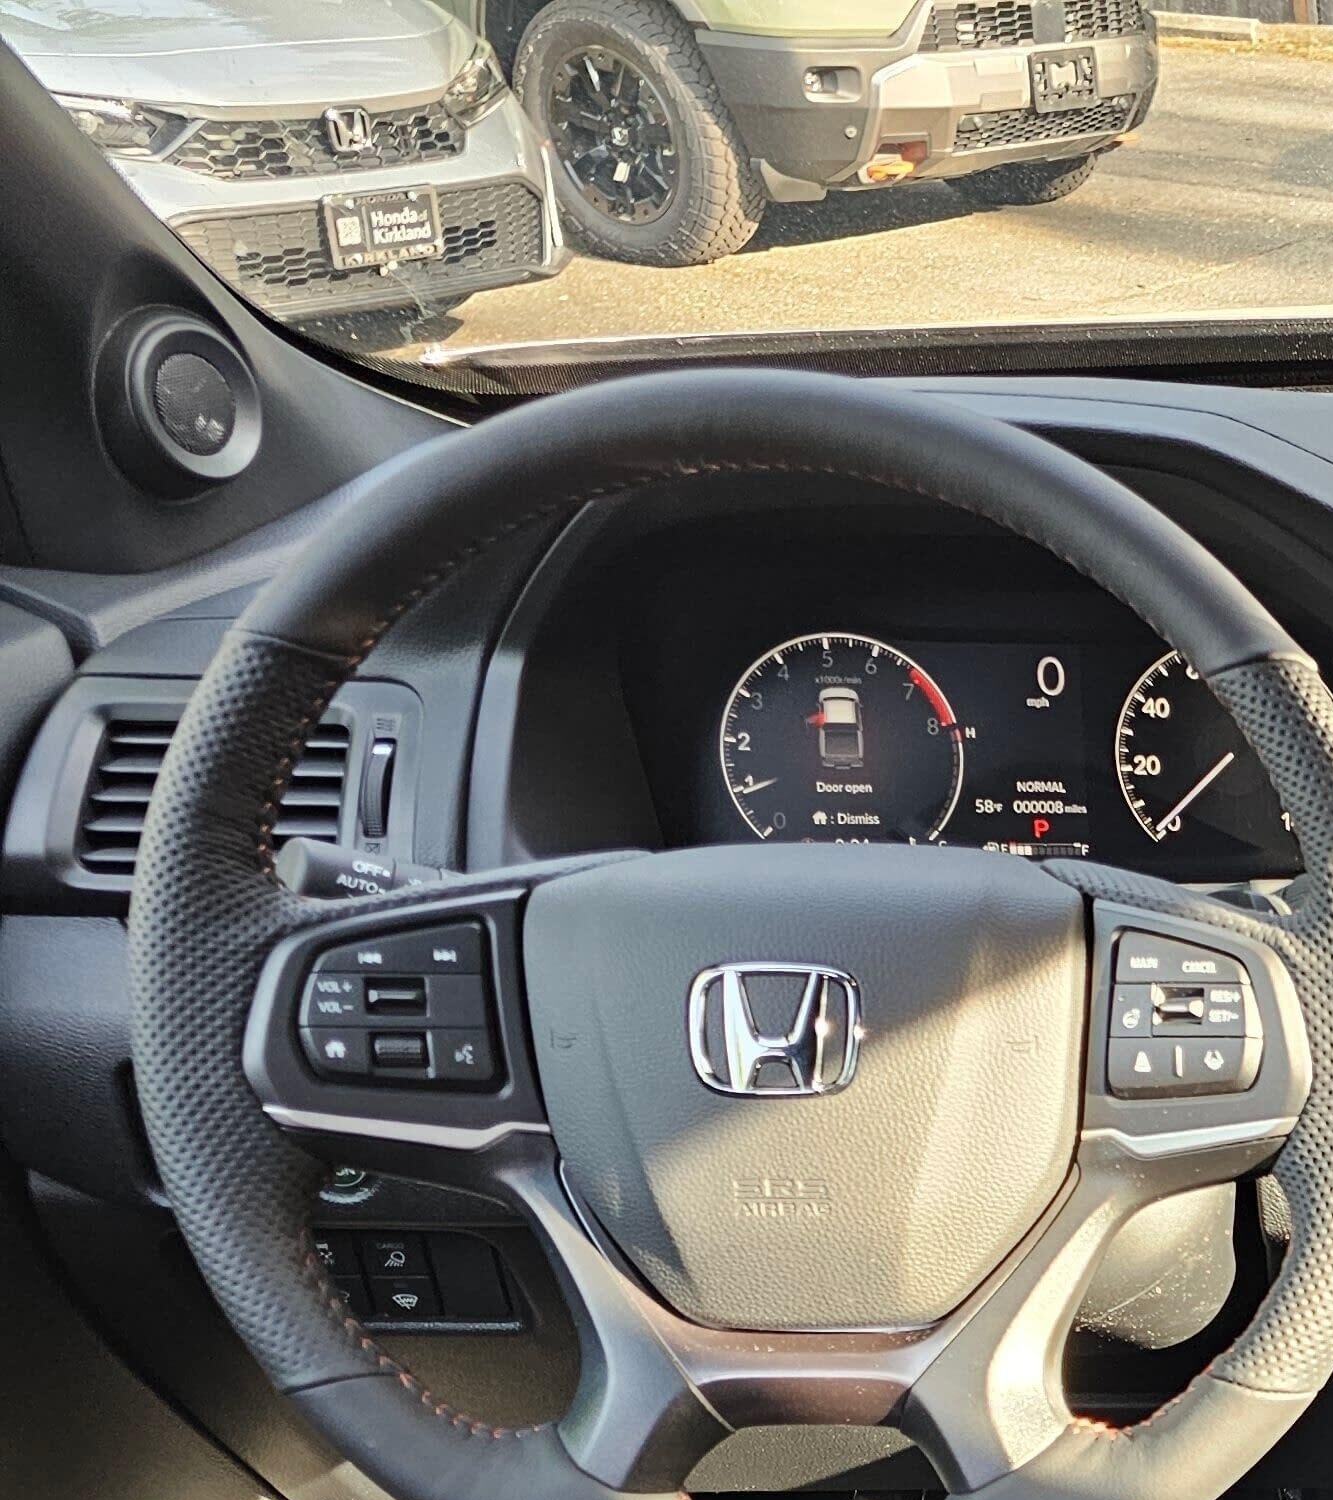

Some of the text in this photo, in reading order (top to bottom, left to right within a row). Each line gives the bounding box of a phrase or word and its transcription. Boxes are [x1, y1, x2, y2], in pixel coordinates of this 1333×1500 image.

[370, 207, 418, 227] Honda
[373, 221, 432, 245] Kirkland
[1026, 697, 1050, 709] mph
[1141, 698, 1171, 719] 40
[1133, 755, 1161, 776] 20
[816, 781, 873, 796] Door open
[1016, 781, 1067, 794] NORMAL
[1013, 800, 1064, 815] 000008
[837, 813, 881, 826] Dismiss
[1034, 819, 1050, 838] P
[336, 873, 379, 894] AUTO
